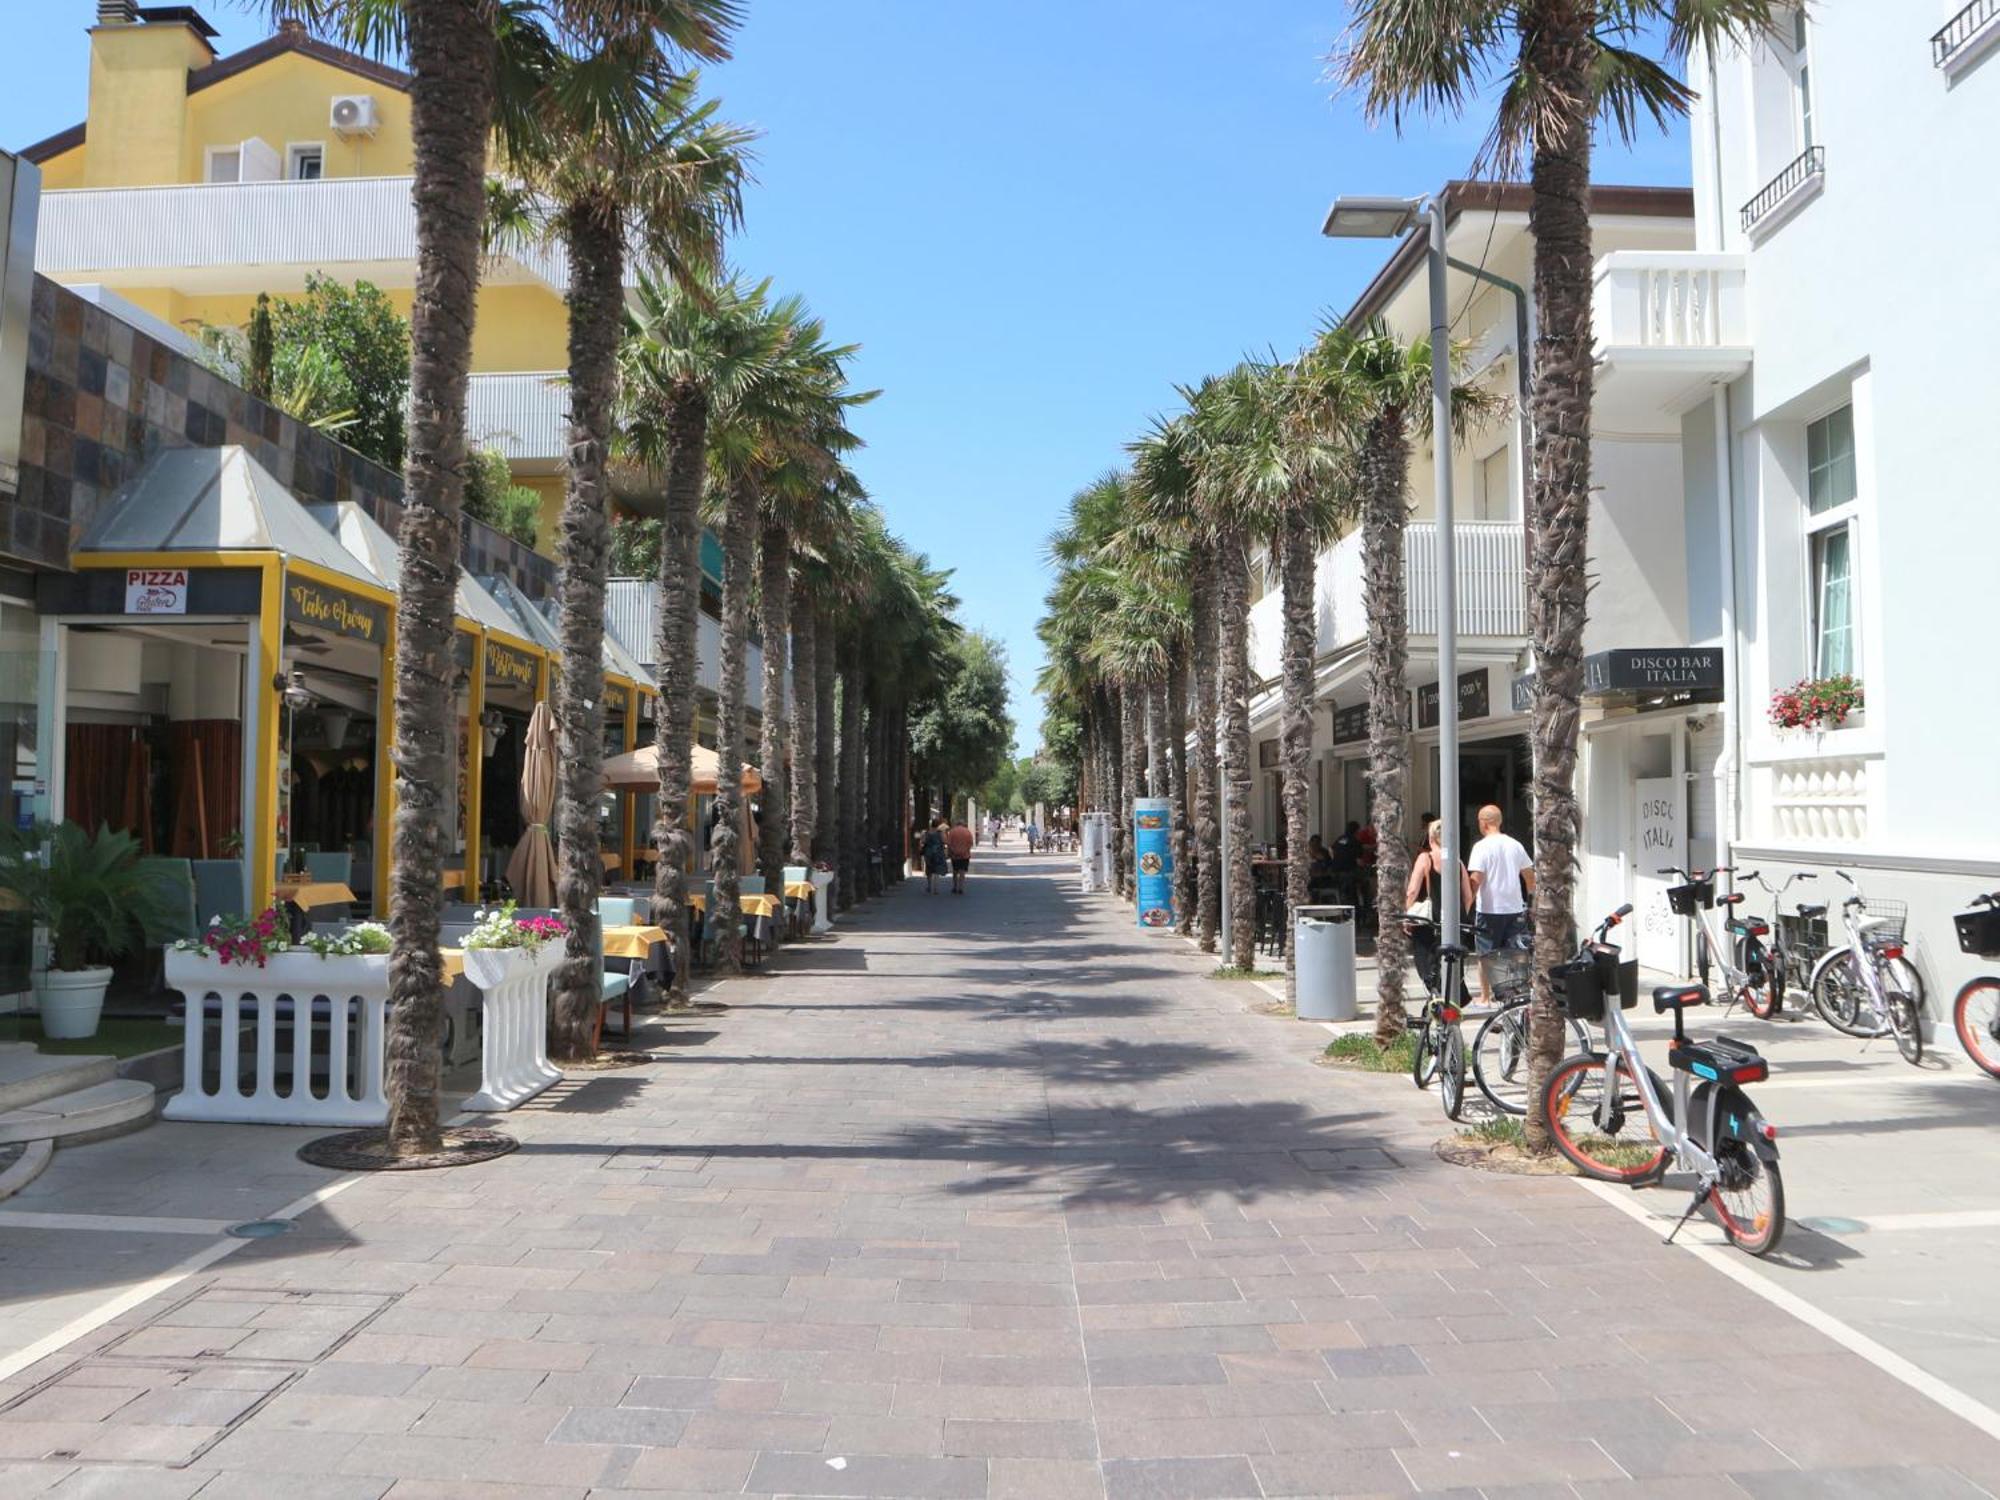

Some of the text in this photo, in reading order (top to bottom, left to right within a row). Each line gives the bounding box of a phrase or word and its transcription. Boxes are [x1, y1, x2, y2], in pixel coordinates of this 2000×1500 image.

[128, 571, 185, 586] PIZZA
[1631, 656, 1712, 669] DISCO BAR
[1647, 670, 1697, 682] ITALIA
